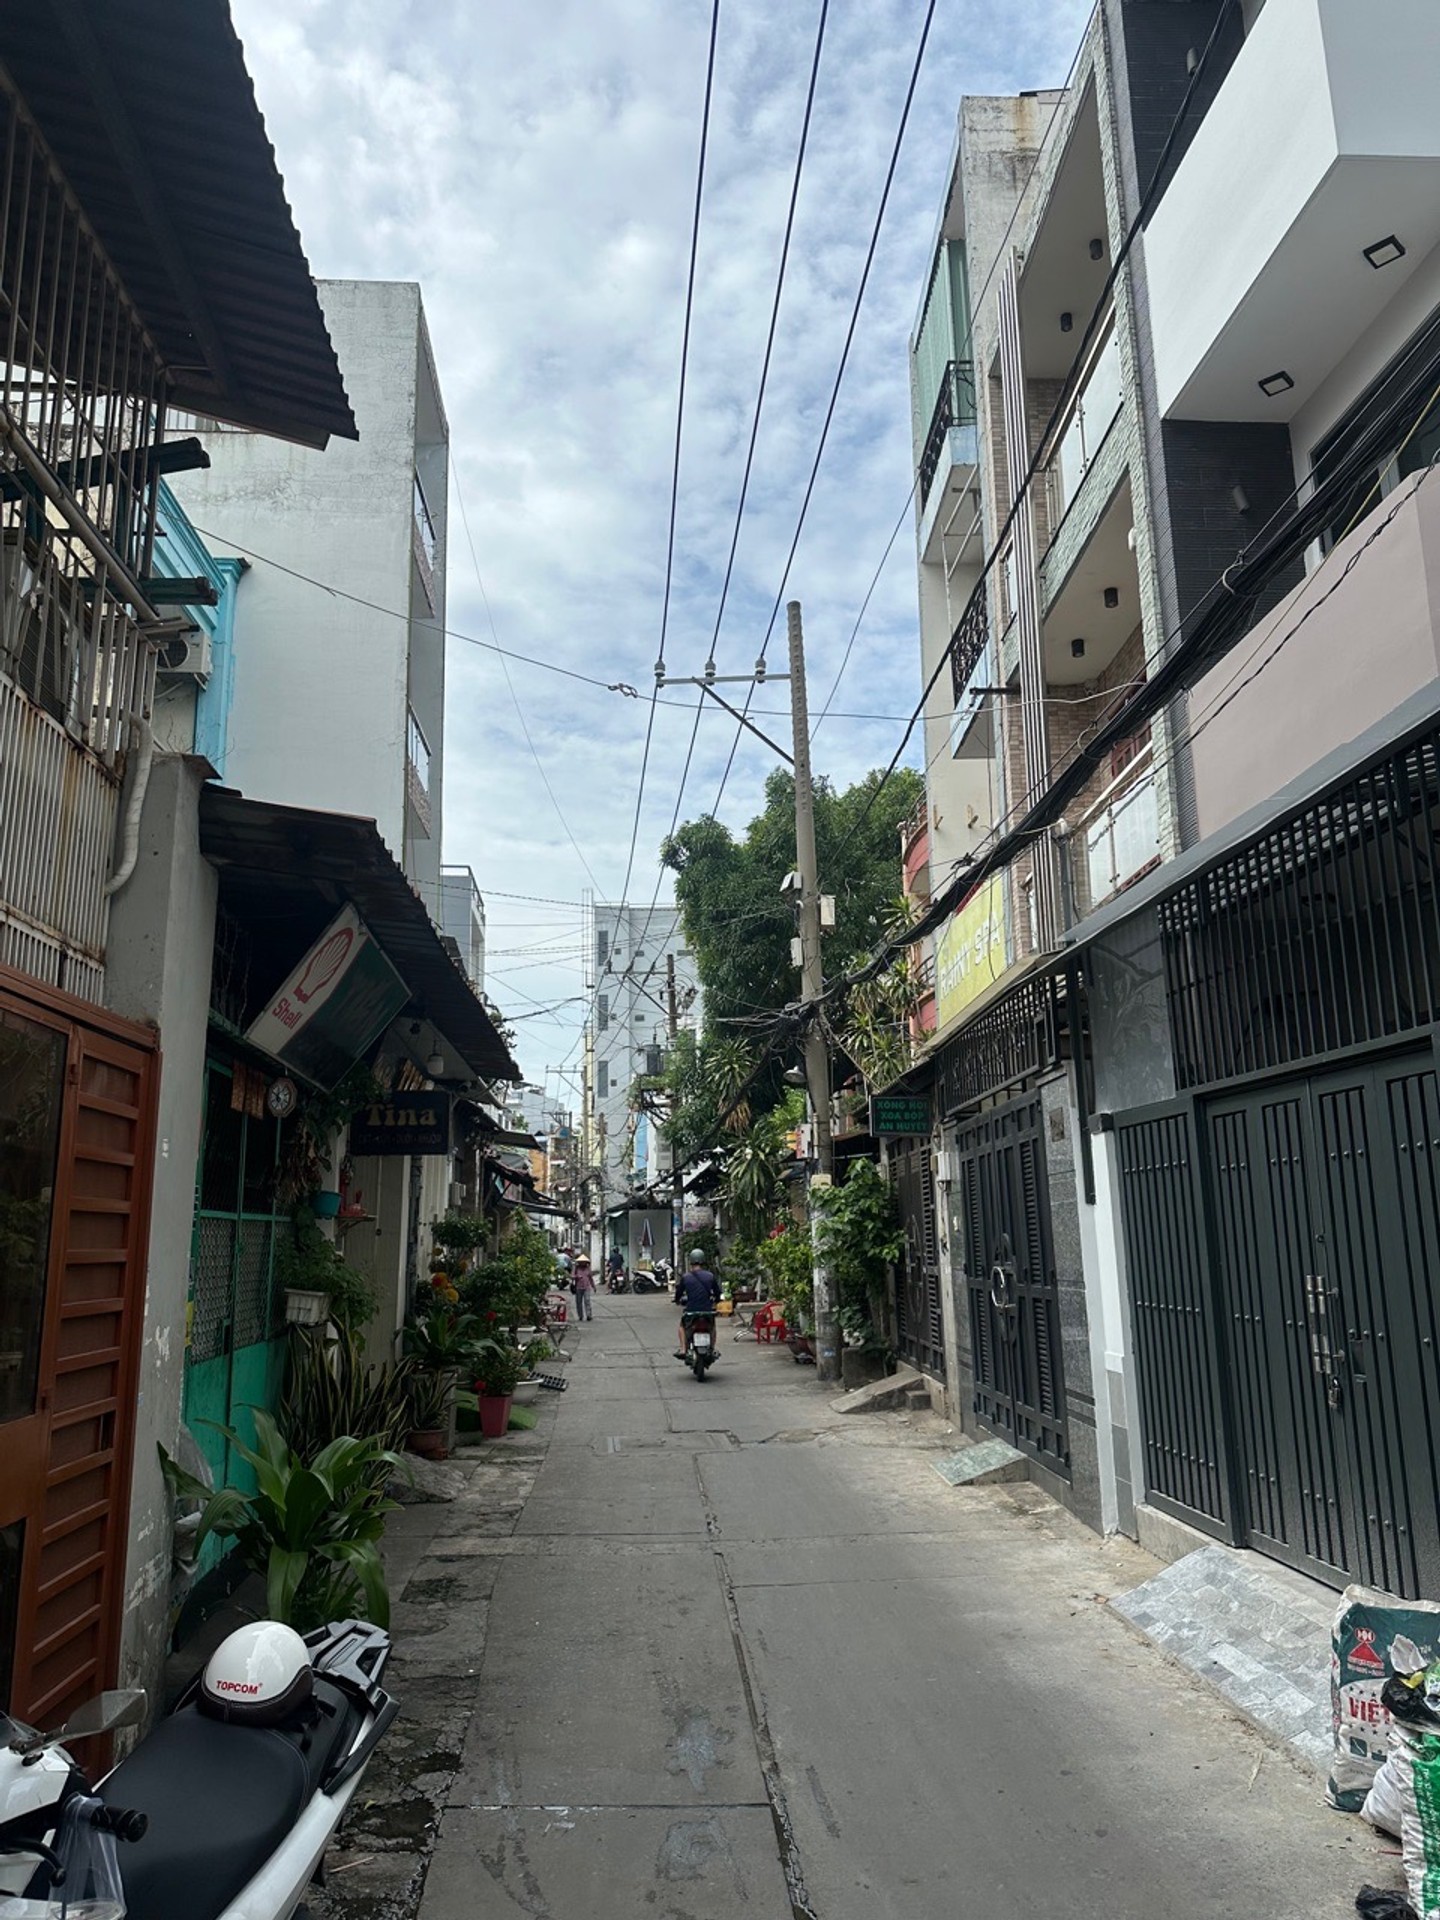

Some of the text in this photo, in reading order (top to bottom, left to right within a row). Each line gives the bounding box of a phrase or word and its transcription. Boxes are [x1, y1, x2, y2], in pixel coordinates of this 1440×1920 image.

[974, 911, 1001, 965] SPA
[272, 998, 302, 1030] Shell
[366, 1102, 437, 1126] Tina
[216, 1680, 258, 1695] TOPCOM
